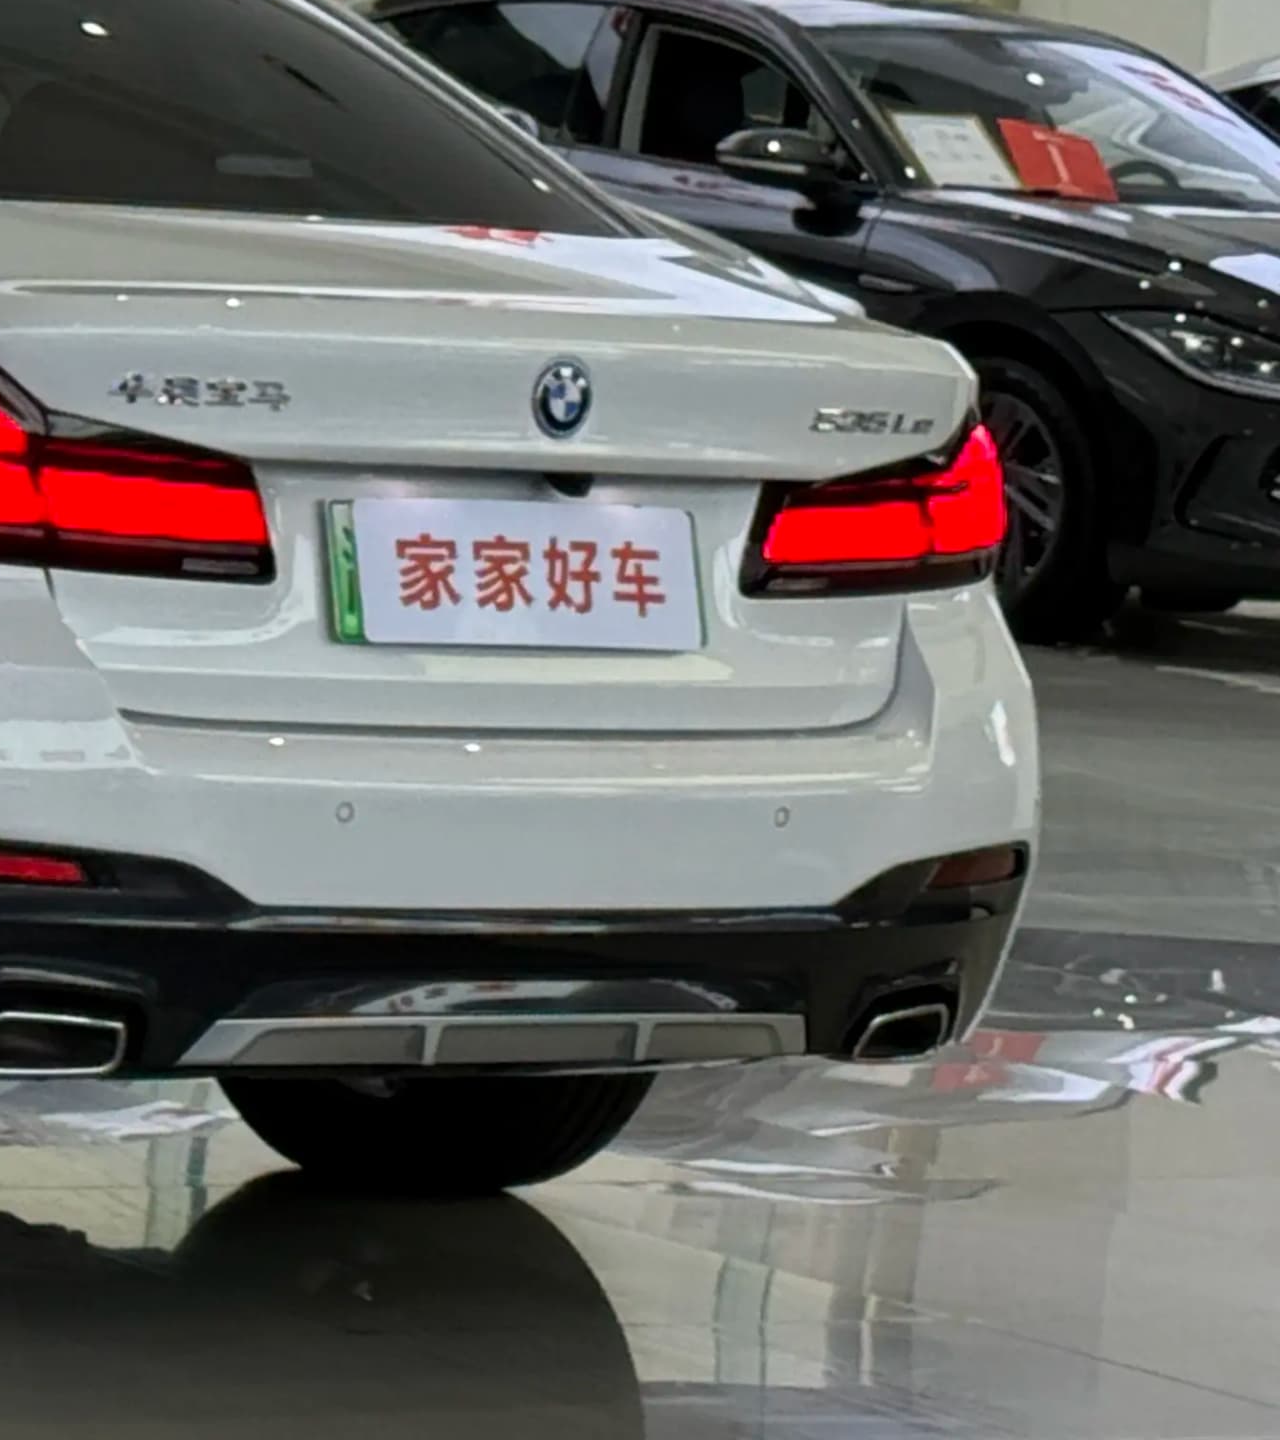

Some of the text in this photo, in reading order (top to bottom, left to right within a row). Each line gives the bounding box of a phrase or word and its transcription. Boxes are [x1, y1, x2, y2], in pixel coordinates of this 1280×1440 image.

[107, 370, 292, 412] 华晨宝马
[394, 532, 667, 618] 家家好车
